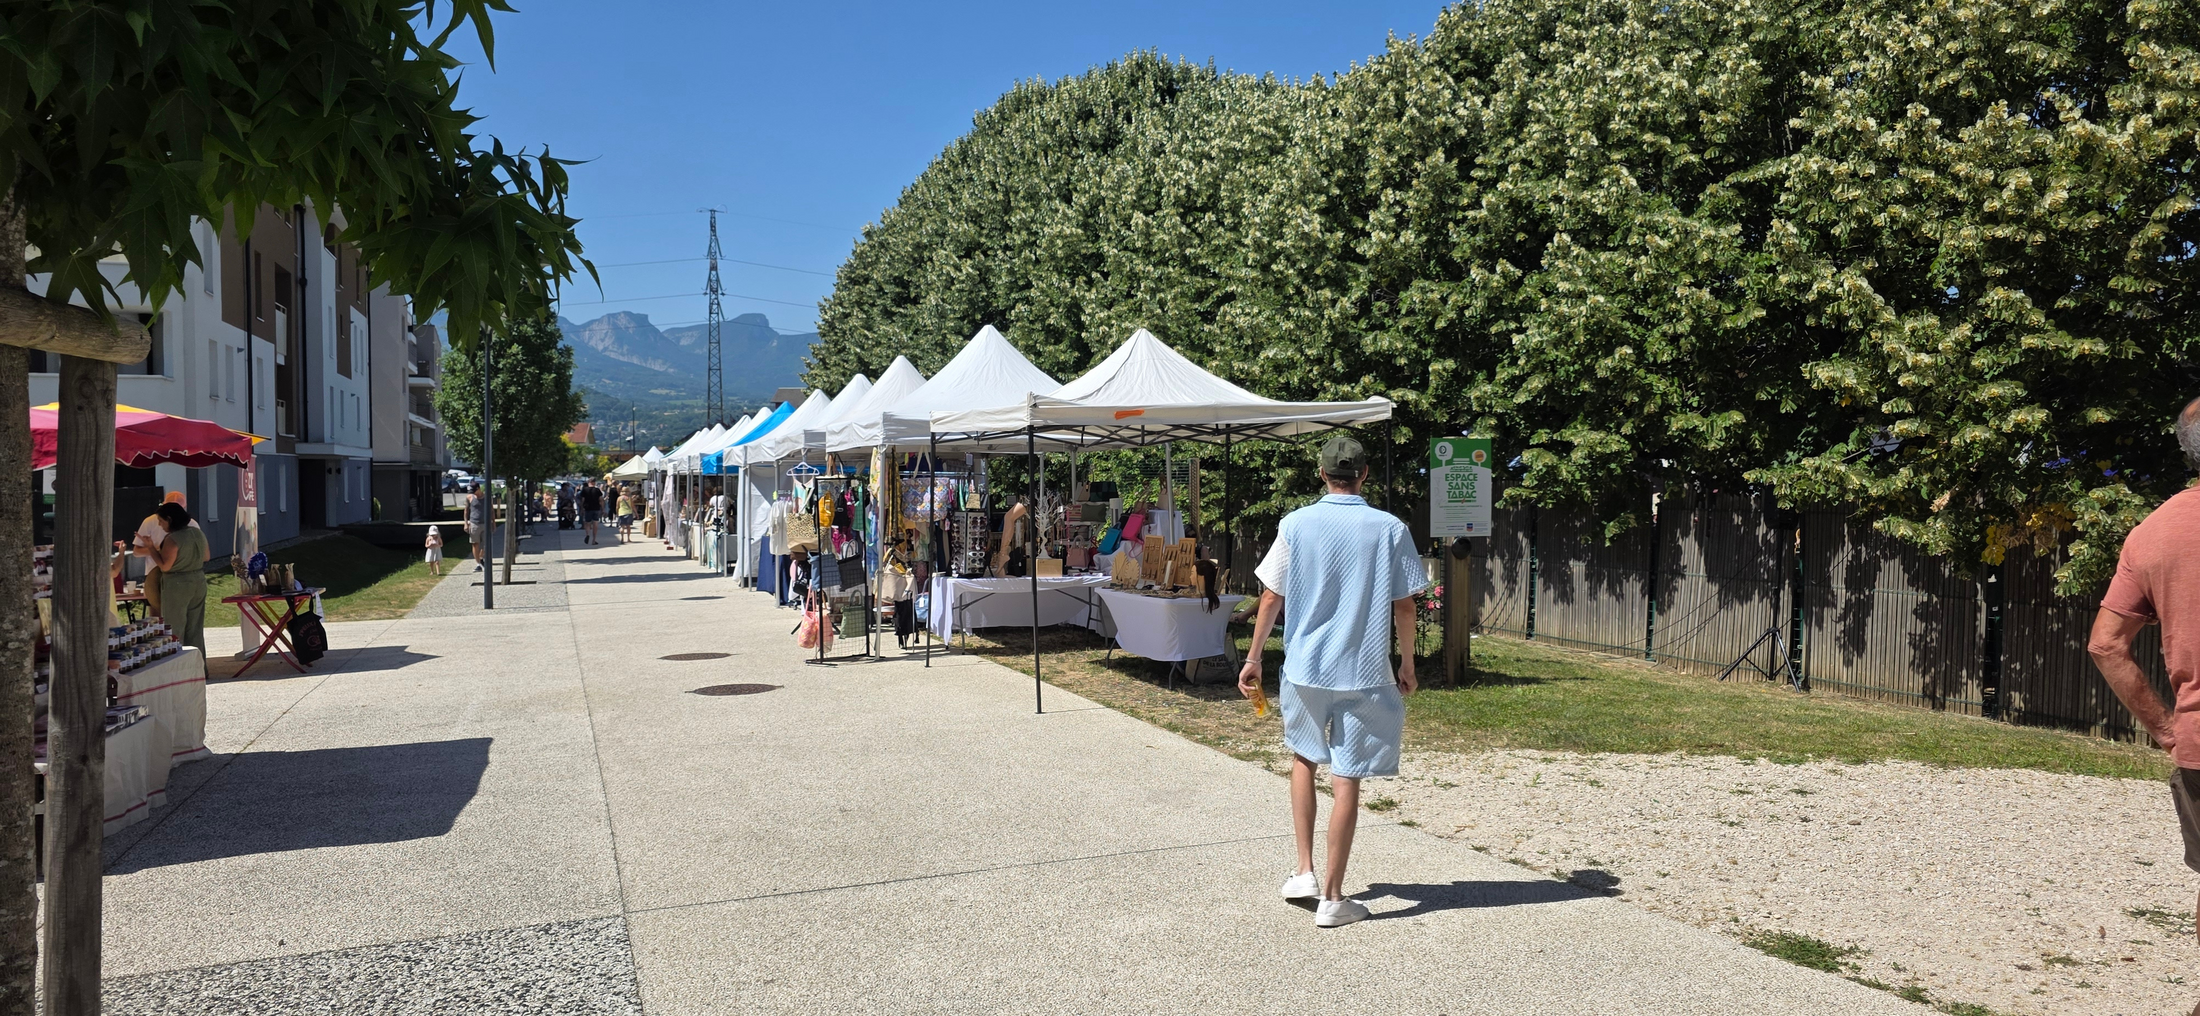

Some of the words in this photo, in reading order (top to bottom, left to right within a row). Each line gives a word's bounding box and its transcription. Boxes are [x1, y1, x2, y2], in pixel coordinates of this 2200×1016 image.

[1445, 473, 1478, 481] ESPACE
[1448, 482, 1475, 490] SANS
[1446, 490, 1477, 499] TABAC
